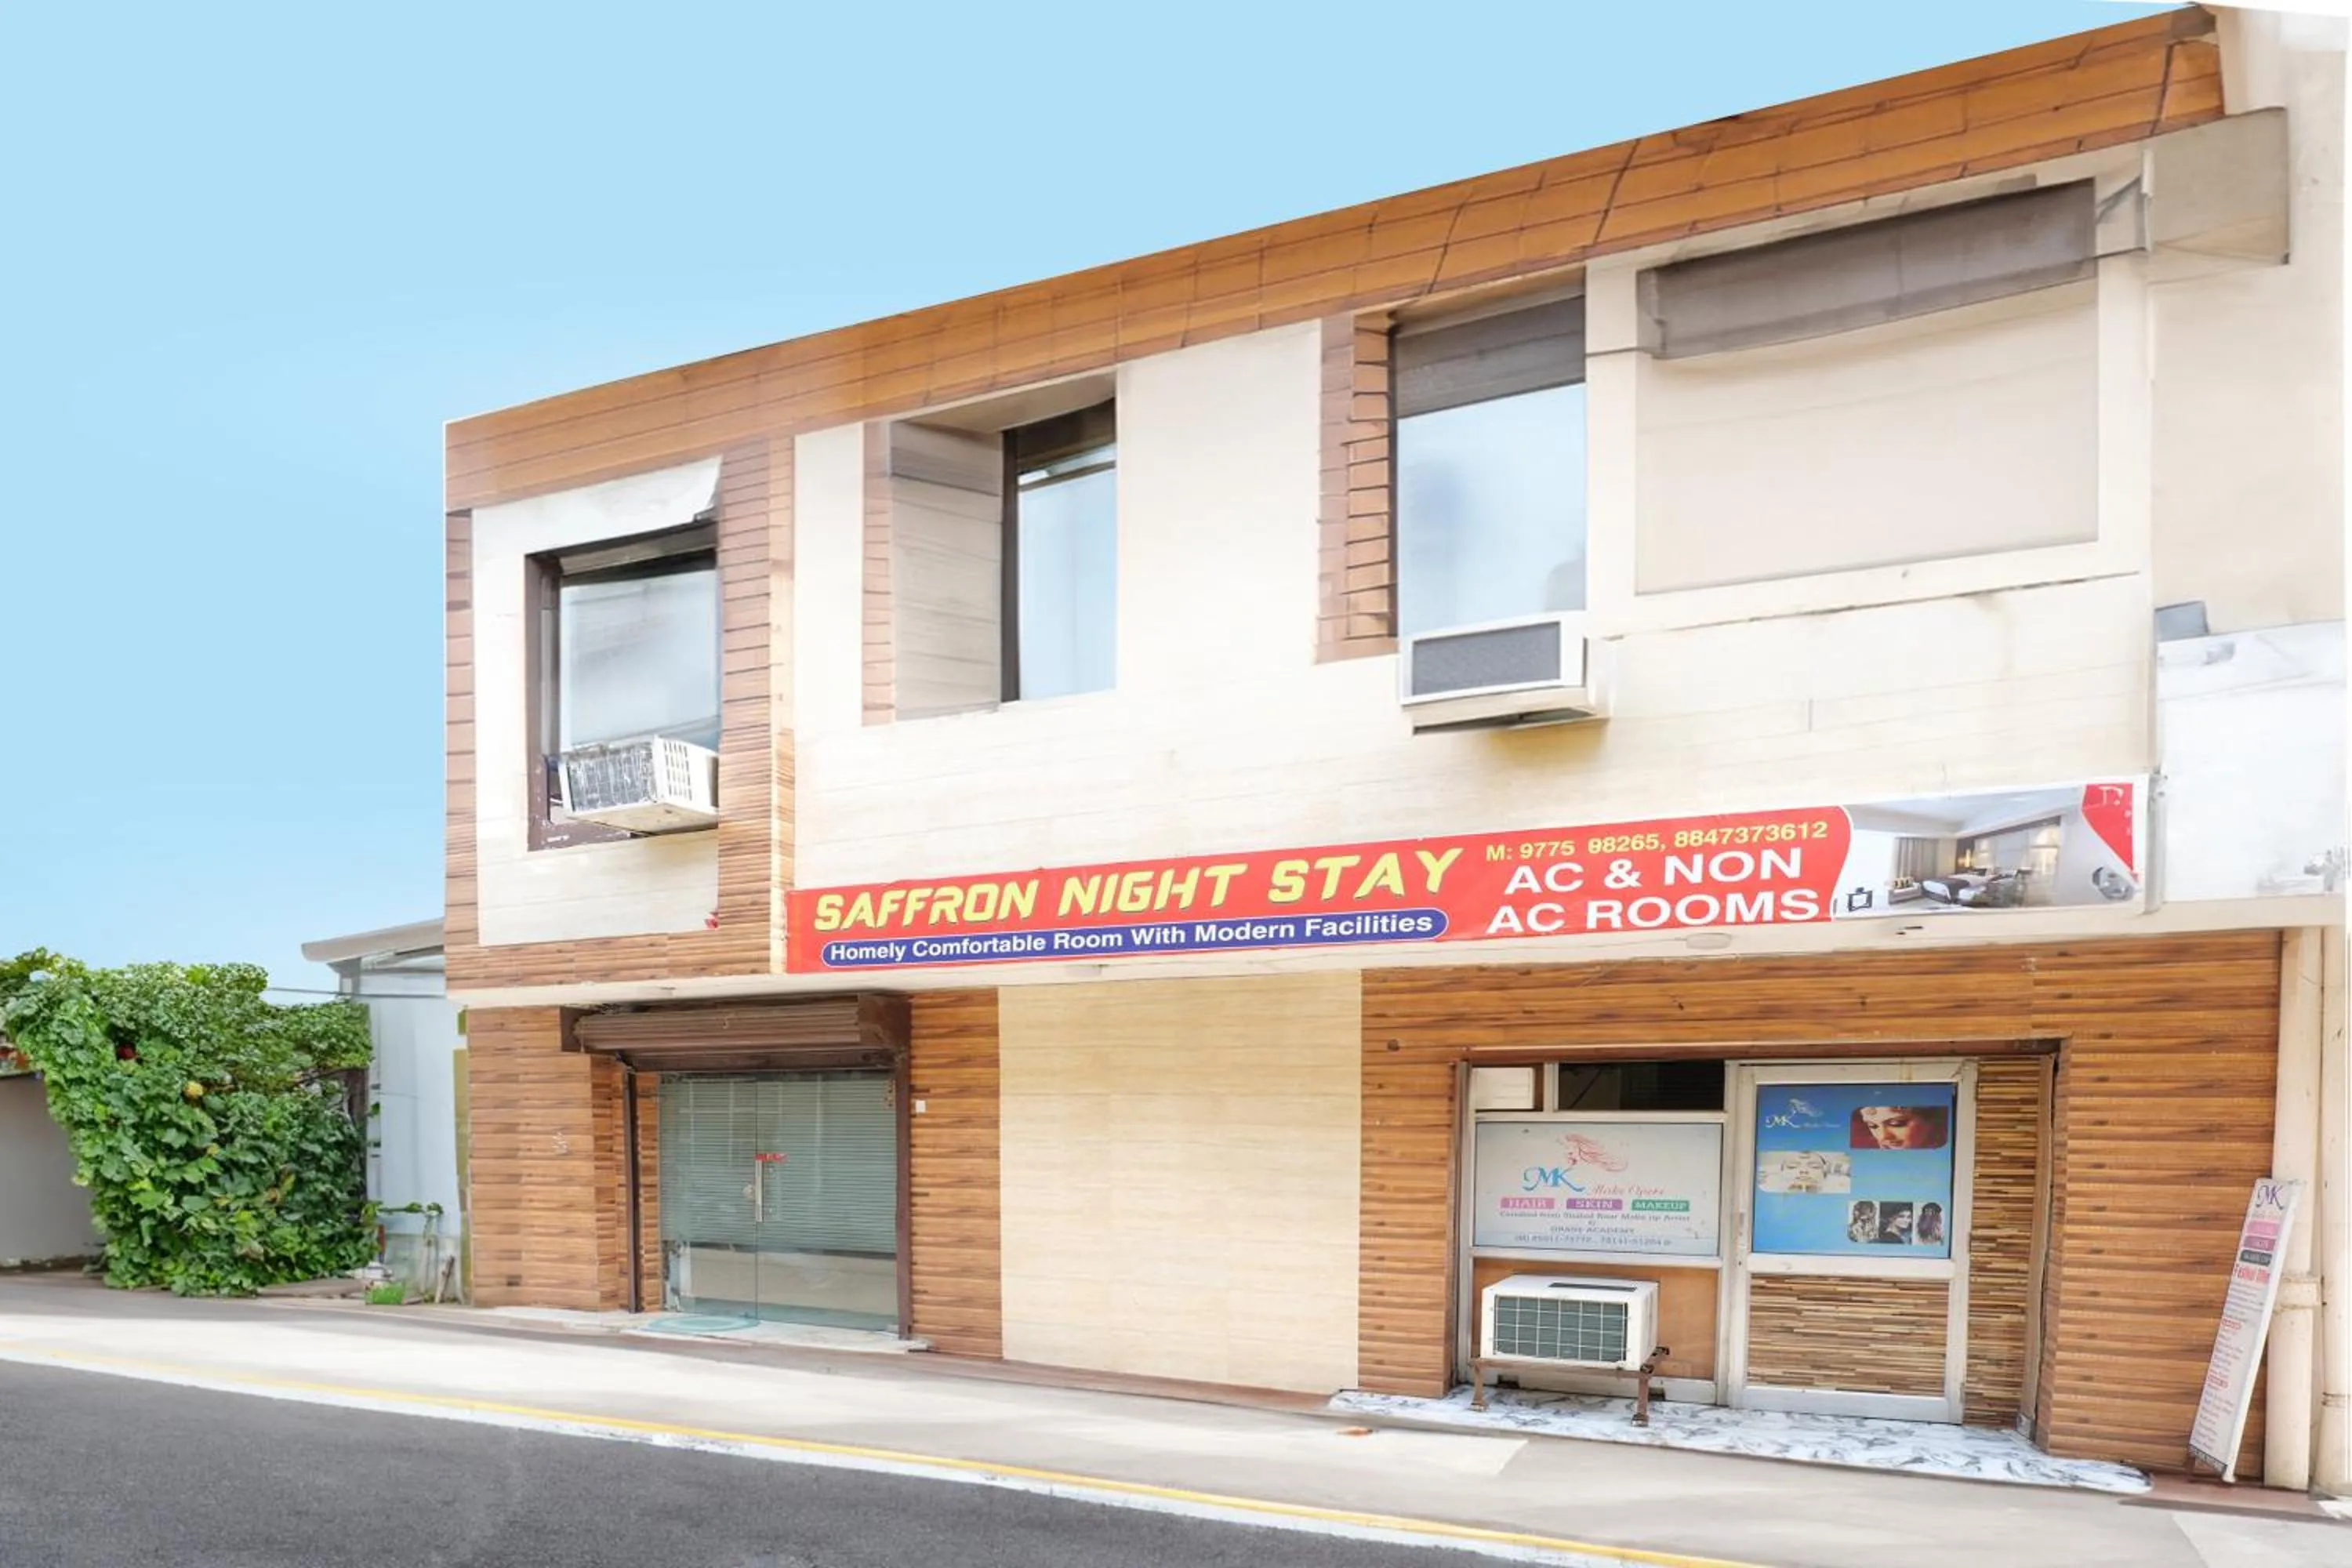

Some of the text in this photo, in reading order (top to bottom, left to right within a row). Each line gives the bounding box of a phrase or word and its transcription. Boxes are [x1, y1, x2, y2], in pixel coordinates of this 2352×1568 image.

[1519, 840, 1575, 858] 9775
[1674, 821, 1828, 848] 8847373612
[814, 848, 1465, 931] SAFFRON NIGHT STAY
[1504, 847, 1802, 895] AC & NON
[1486, 888, 1820, 934] AC ROOMS
[830, 914, 1432, 962] Homely Comfortable Room With Modern Facilities
[1522, 1167, 1585, 1192] MK
[2255, 1184, 2285, 1210] MK
[1508, 1199, 1548, 1208] HAIR
[1574, 1200, 1614, 1209] SKIN
